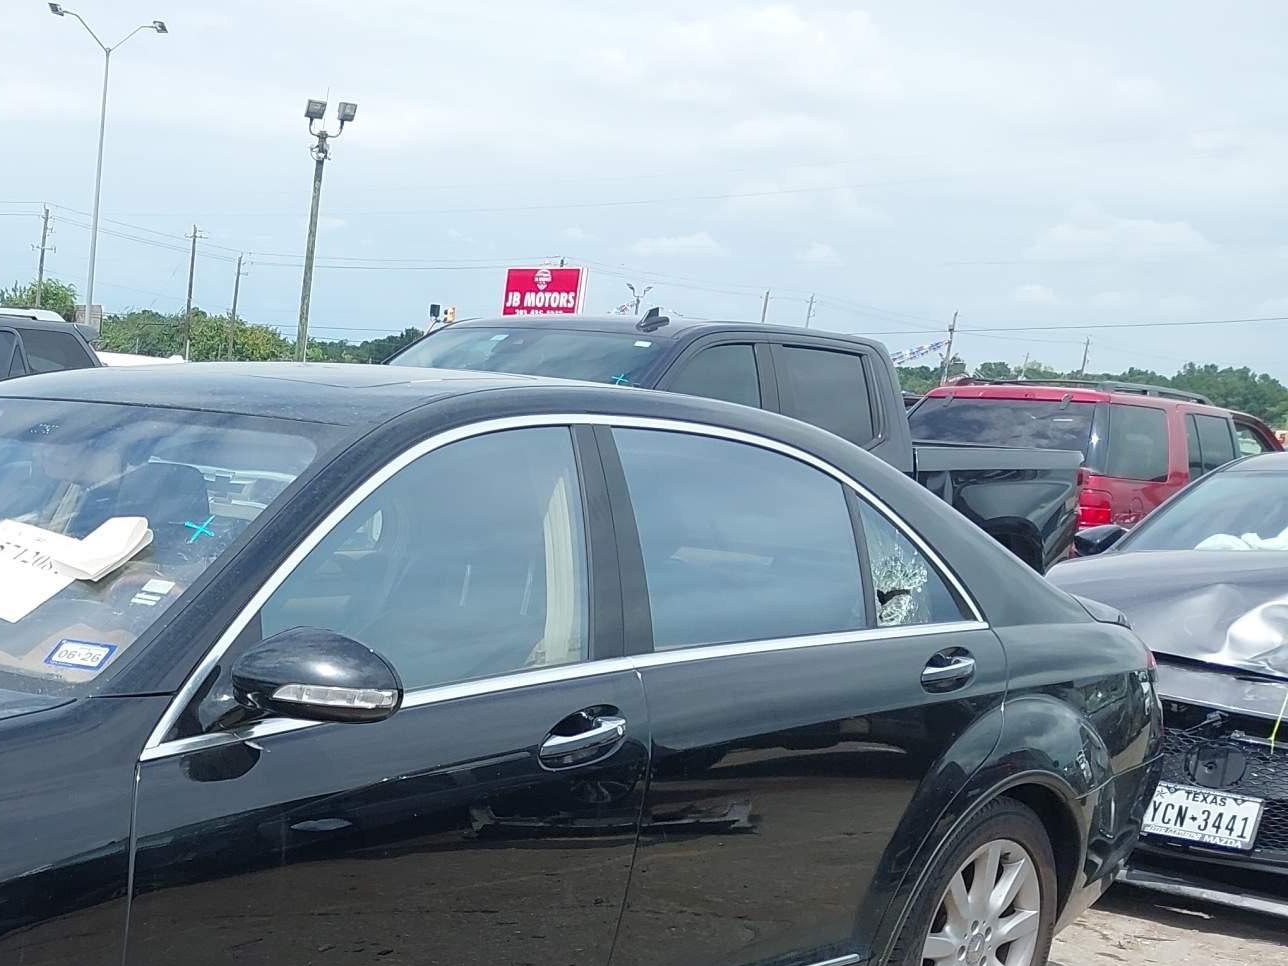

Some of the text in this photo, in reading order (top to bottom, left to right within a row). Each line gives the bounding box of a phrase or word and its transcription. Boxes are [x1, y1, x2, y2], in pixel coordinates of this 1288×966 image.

[506, 291, 576, 308] JB MOTORS
[1184, 791, 1227, 807] TEXAS
[1151, 800, 1189, 828] YCN
[1197, 809, 1249, 840] 3441
[1202, 835, 1242, 848] MAZDA
